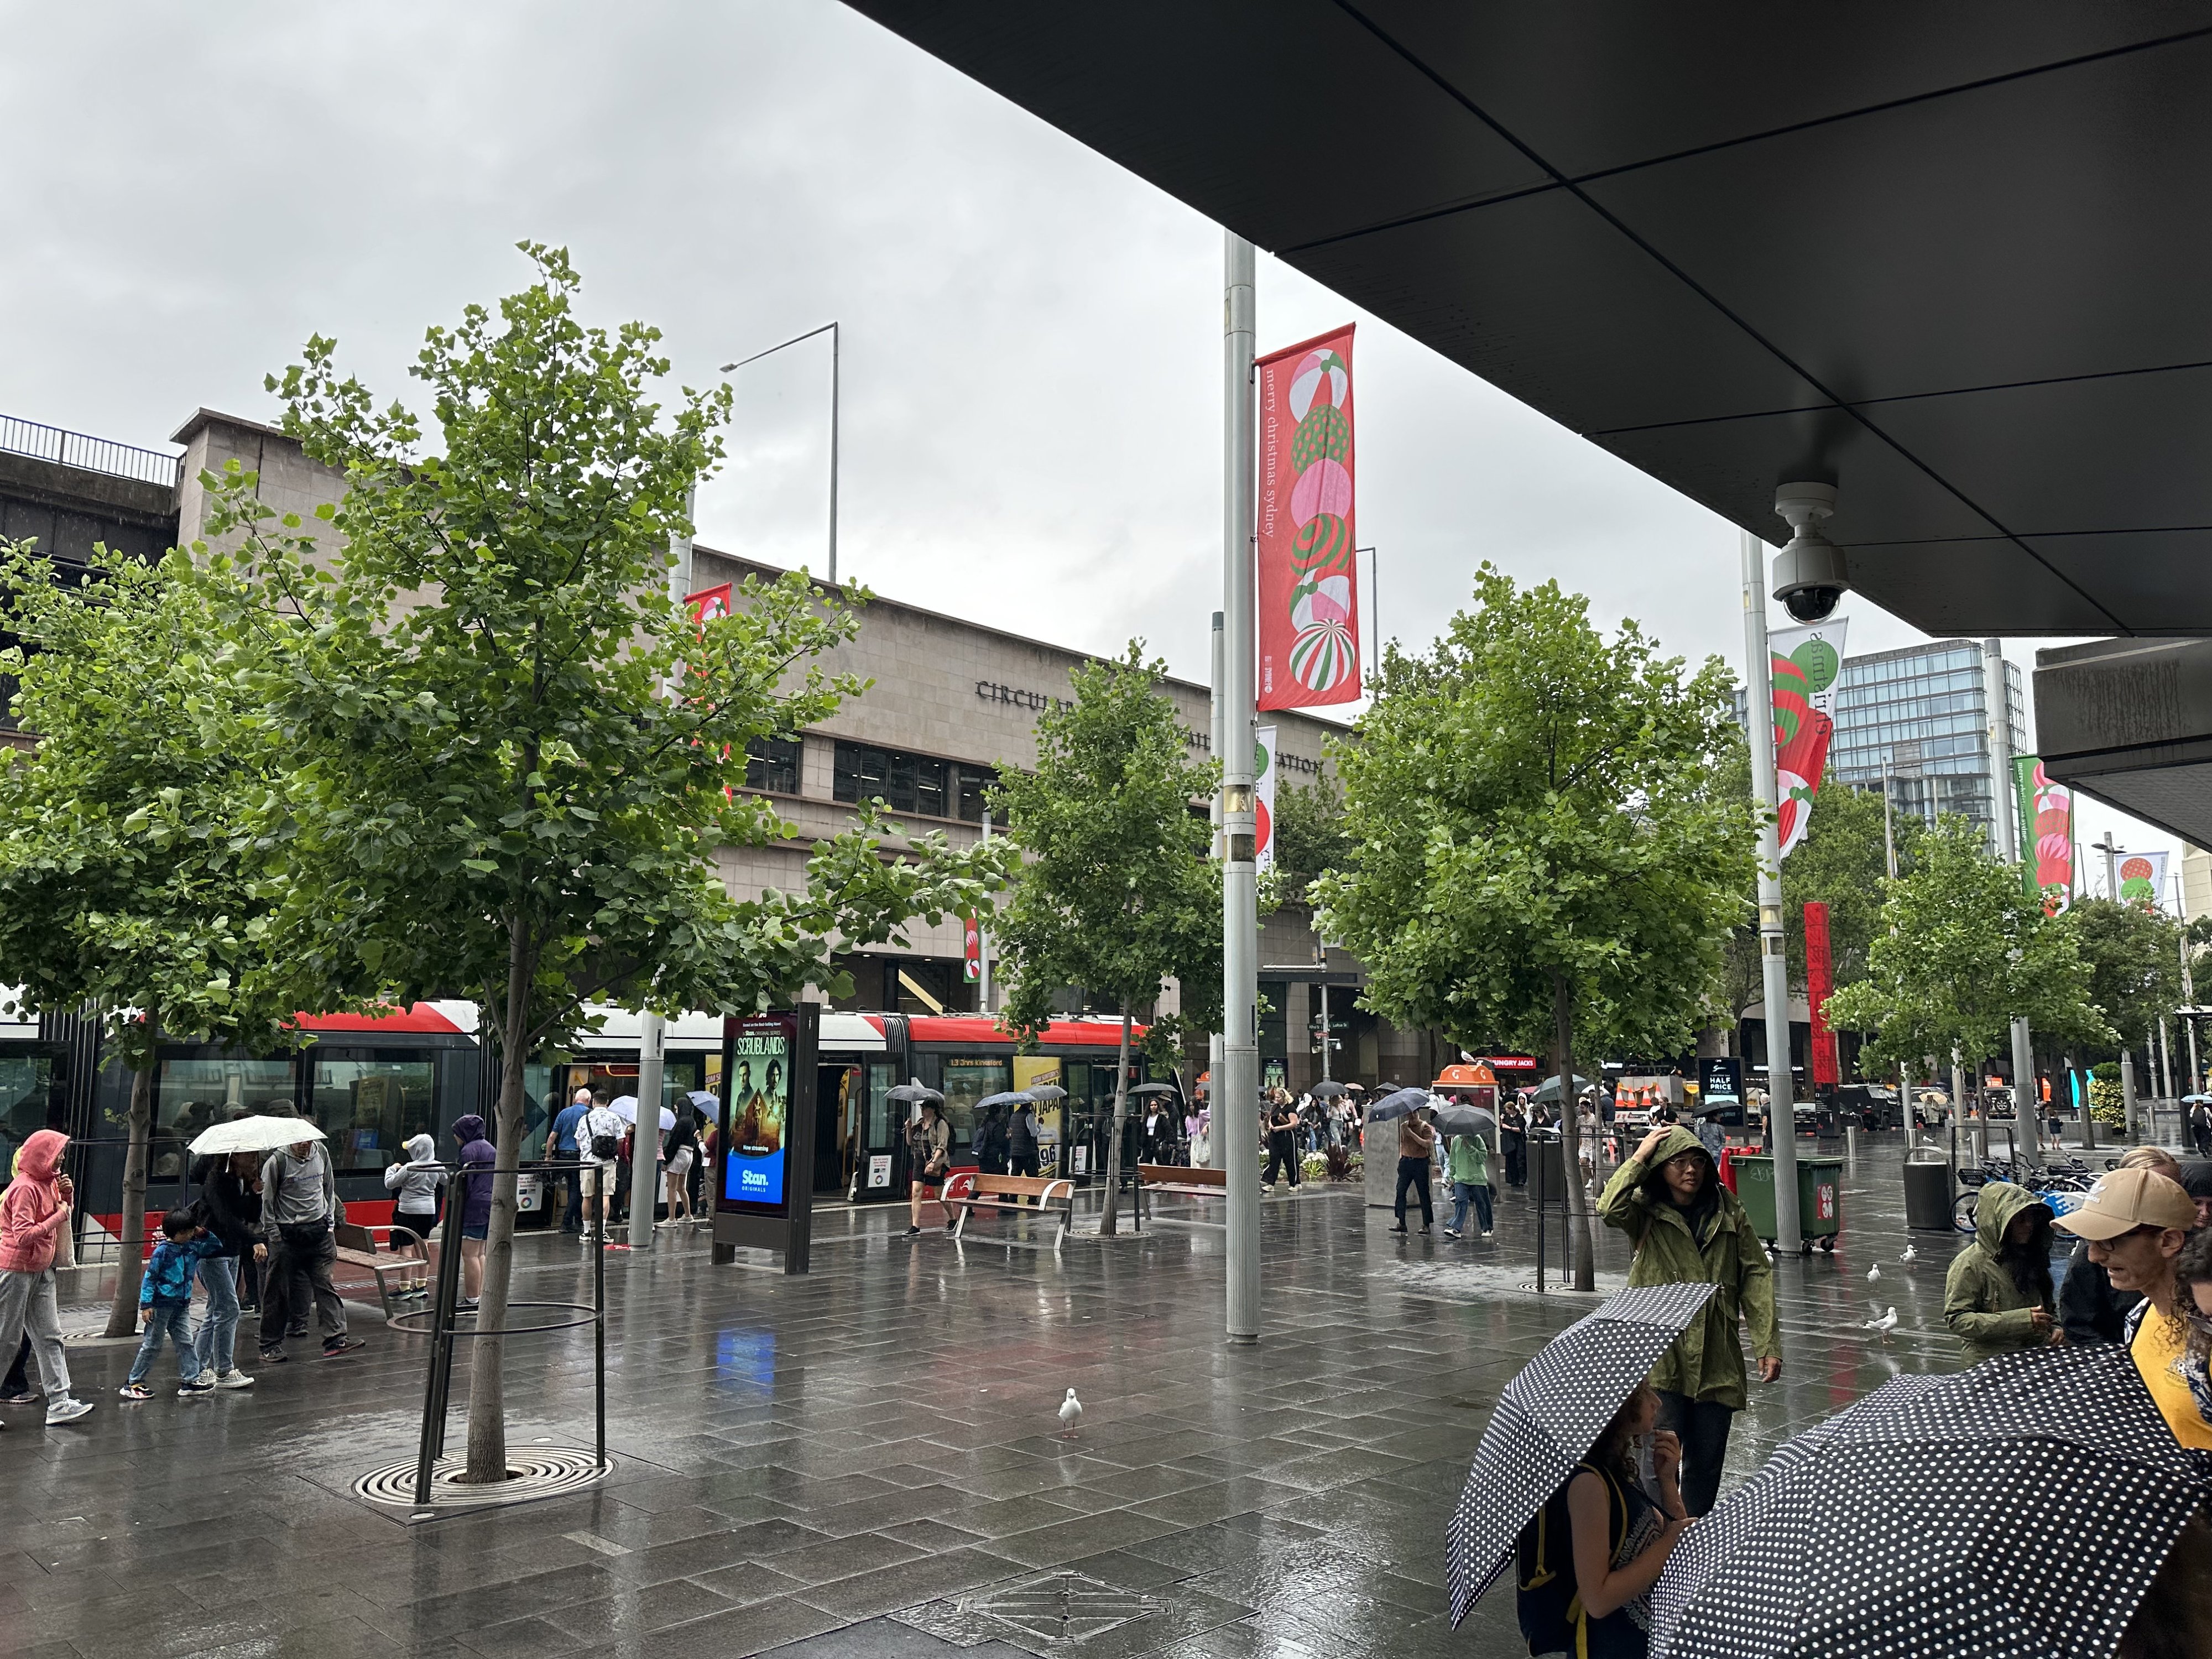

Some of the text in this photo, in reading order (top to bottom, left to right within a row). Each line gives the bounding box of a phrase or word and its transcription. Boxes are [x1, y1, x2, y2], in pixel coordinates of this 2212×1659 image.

[1261, 369, 1279, 538] merry christmas sydney
[737, 1036, 785, 1056] SCRUBLANDS
[742, 1170, 769, 1186] Stan.
